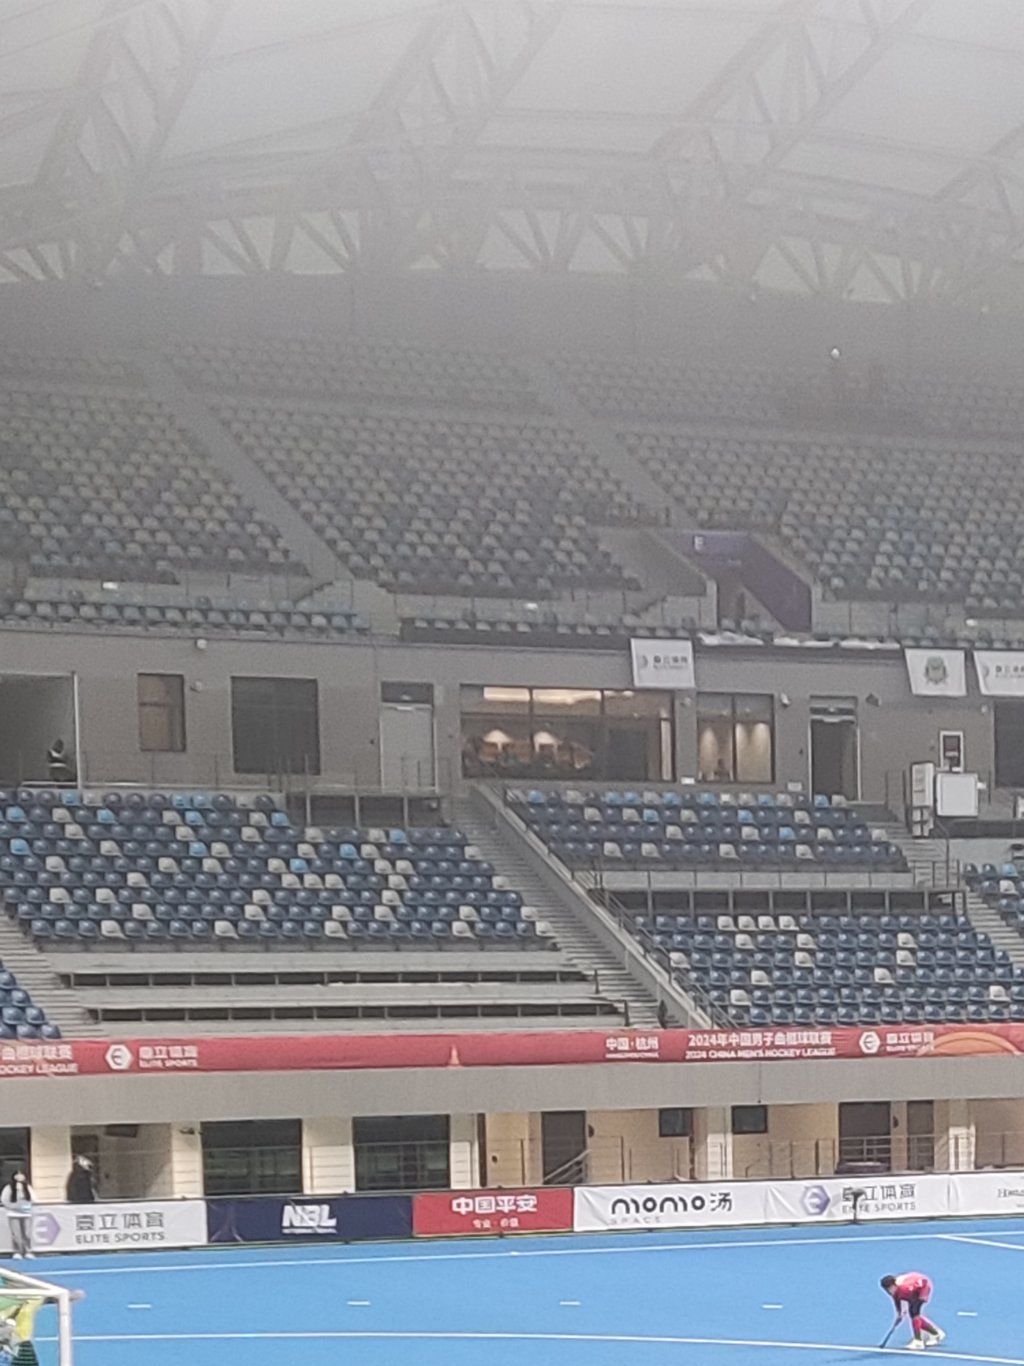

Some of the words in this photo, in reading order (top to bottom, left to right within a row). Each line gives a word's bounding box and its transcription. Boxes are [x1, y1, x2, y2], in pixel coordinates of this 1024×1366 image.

[708, 1050, 736, 1059] CHINA
[765, 1048, 800, 1058] HOCKEY
[802, 1047, 836, 1057] LEAGUE
[36, 1063, 78, 1074] LEAGUE
[451, 1194, 538, 1216] 中国平安
[874, 1201, 916, 1212] SPORTS
[281, 1204, 337, 1227] NBL
[75, 1233, 110, 1245] ELITE
[114, 1231, 165, 1243] SPORTS
